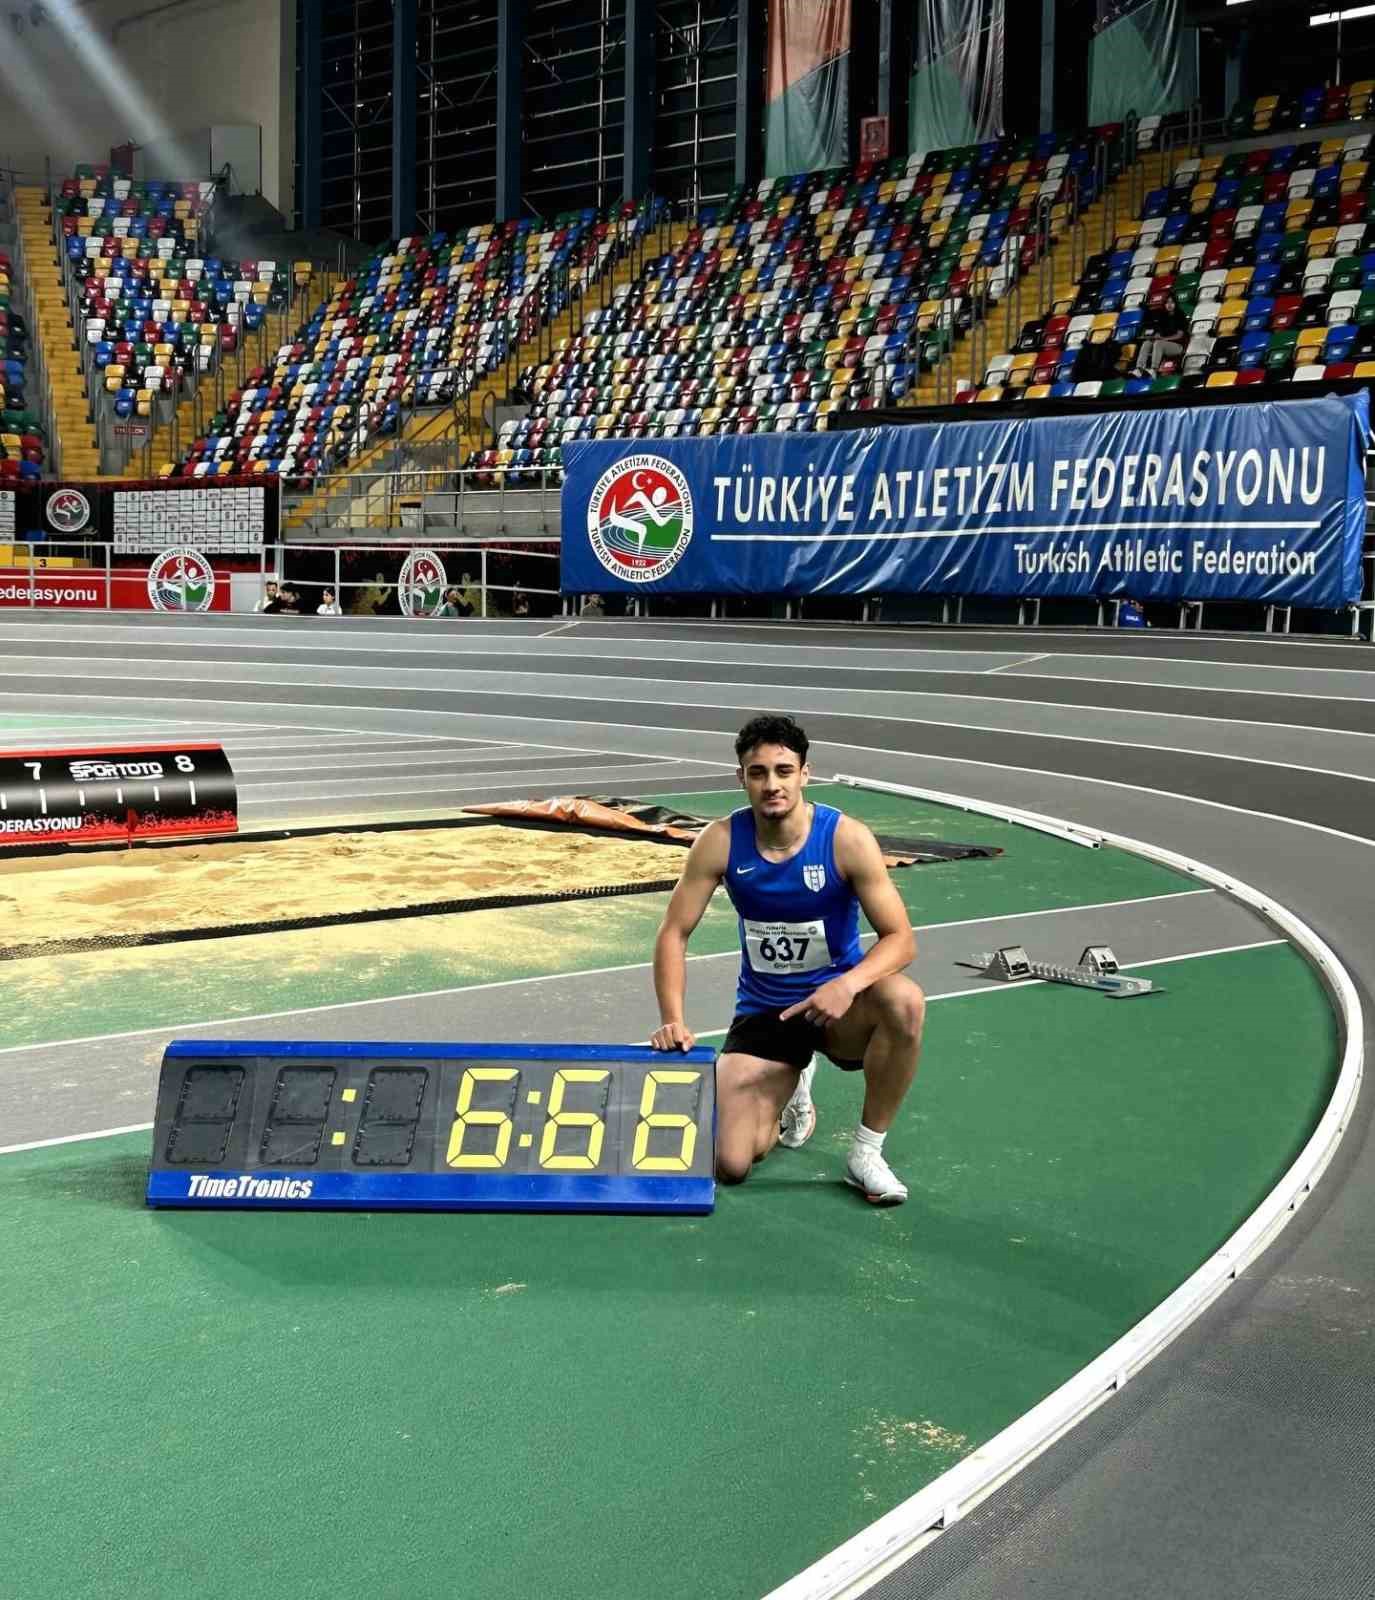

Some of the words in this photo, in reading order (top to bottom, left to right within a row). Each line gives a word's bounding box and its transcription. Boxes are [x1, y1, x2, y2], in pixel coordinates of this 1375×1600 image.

[650, 458, 692, 515] FEDERASYONU
[714, 464, 854, 523] TÜRKİYE
[869, 452, 1034, 521] ATLETİZM
[1051, 446, 1325, 511] FEDERASYONU
[40, 558, 47, 568] 3
[590, 527, 613, 567] TURKISH
[611, 561, 650, 580] ATHLETIC
[651, 528, 691, 576] FEDERATION
[1014, 540, 1090, 575] Turkish
[1099, 539, 1183, 574] Athletic
[1192, 541, 1316, 576] Federation
[24, 762, 42, 781] 7
[174, 755, 196, 773] 8
[760, 936, 811, 961] 637
[187, 1175, 313, 1199] TimeTronics
